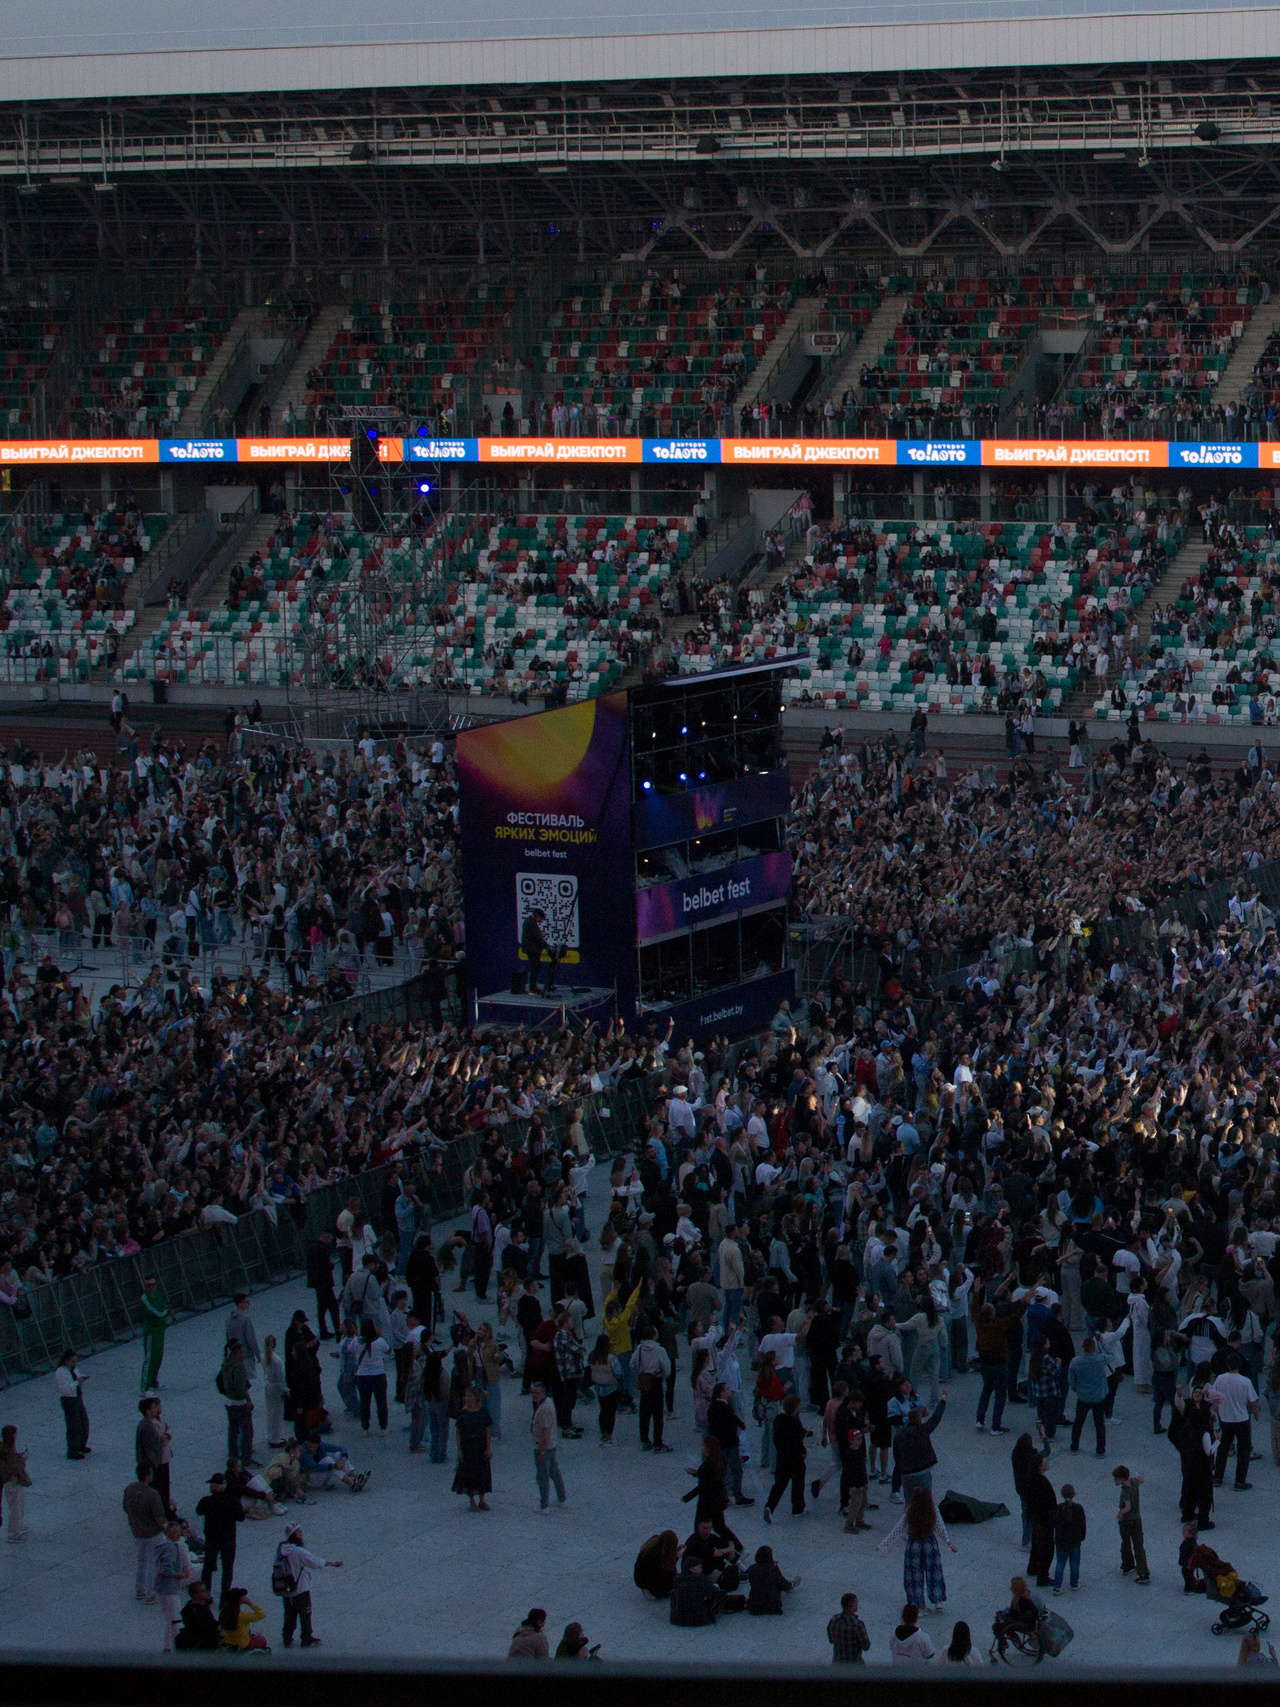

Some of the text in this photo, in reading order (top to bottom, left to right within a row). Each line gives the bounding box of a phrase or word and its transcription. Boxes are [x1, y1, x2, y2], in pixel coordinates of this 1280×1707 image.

[1, 445, 143, 460] ВЫИГРАЙ ДЖЕКПОТ!
[250, 443, 316, 457] ВЫИГРАЙ
[491, 443, 626, 459] ВЫИГРАЙ ДЖЕКПОТ!
[734, 444, 879, 461] ВЫИГРАЙ ДЖЕКПОТ!
[995, 446, 1149, 463] ВЫИГРАЙ ДЖЕКПОТ!
[506, 811, 585, 828] ФЕСТИВАЛЬ
[494, 826, 598, 845] ЯРКИХ ЭМОЦИЙ
[524, 848, 567, 859] belbet fest
[682, 876, 751, 912] belbet fest
[699, 1004, 744, 1026] fest.belbet.by
